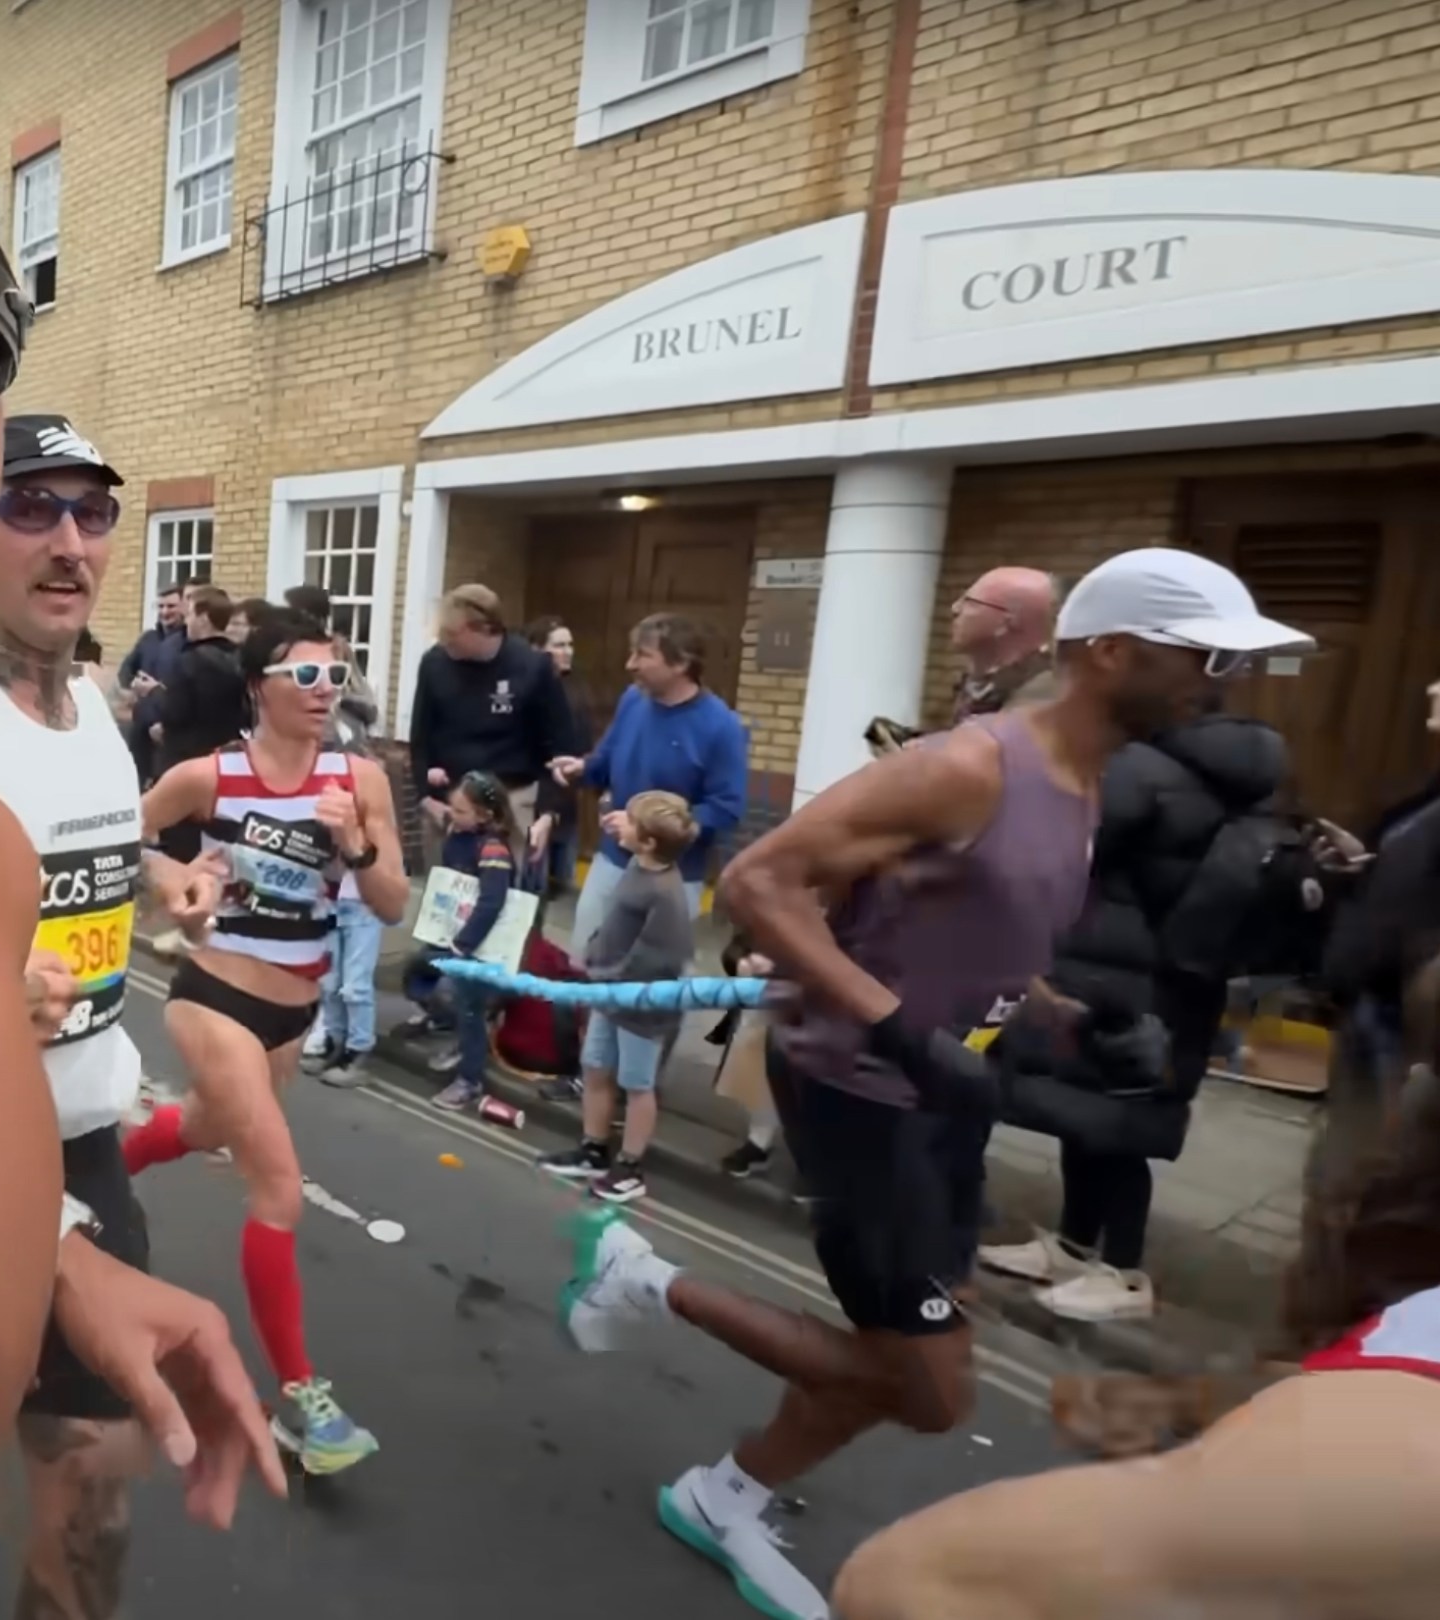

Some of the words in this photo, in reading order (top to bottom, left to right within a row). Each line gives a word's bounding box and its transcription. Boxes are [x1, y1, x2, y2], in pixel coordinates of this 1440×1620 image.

[632, 305, 802, 364] BRUNEL
[962, 235, 1187, 311] COURT
[93, 853, 124, 871] TATA
[67, 923, 118, 976] 396
